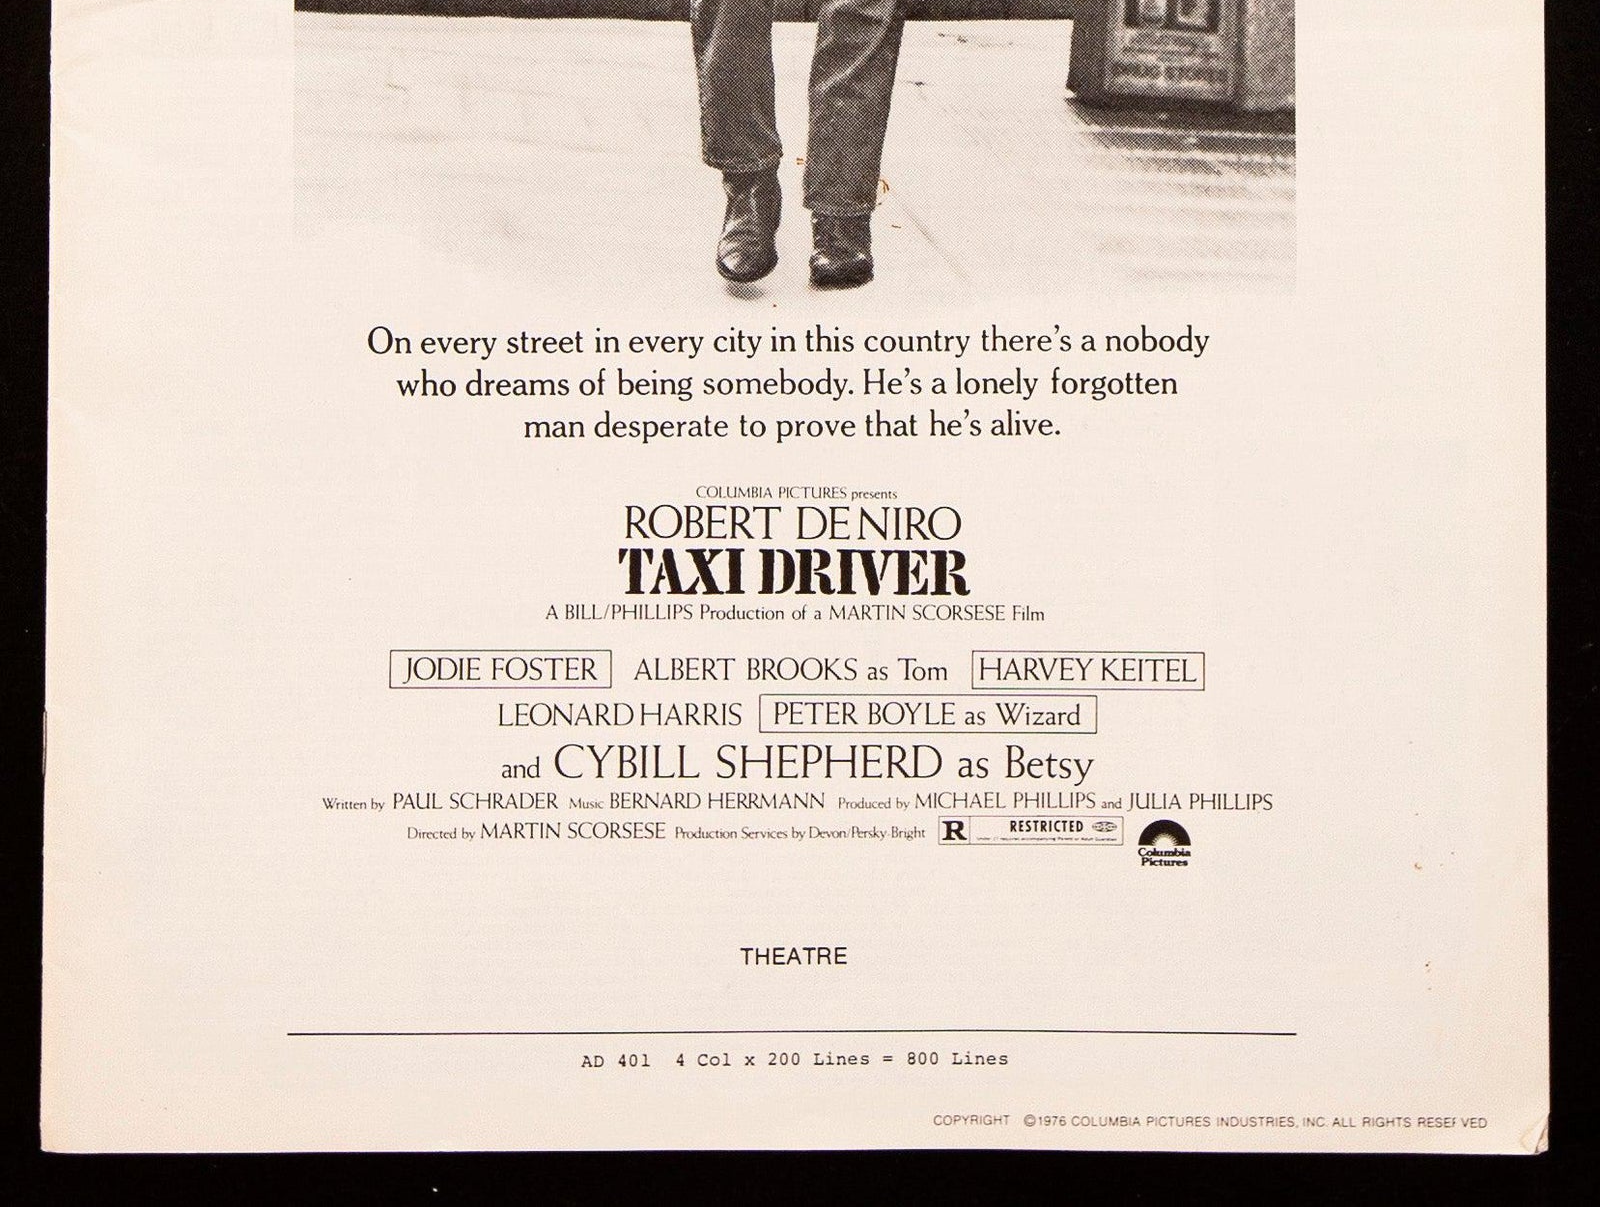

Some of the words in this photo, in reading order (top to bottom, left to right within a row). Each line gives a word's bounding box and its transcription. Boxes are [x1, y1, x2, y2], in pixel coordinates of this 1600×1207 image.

[367, 325, 412, 355] On
[420, 336, 498, 361] every
[506, 330, 584, 355] street
[594, 327, 621, 354] in
[628, 335, 705, 360] every
[713, 326, 763, 359] city
[770, 326, 797, 353] in
[805, 324, 855, 353] this
[863, 329, 971, 359] country
[981, 324, 1072, 353] there’s
[1080, 334, 1097, 352] a
[1105, 324, 1210, 359] nobody
[396, 368, 457, 397] who
[465, 368, 570, 397] dreams
[578, 367, 607, 397] of
[616, 367, 693, 402] being
[703, 367, 854, 402] somebody.
[863, 367, 923, 395] He’s
[931, 377, 948, 395] a
[955, 366, 1039, 401] lonely
[1051, 366, 1178, 402] forgotten
[524, 420, 585, 439] man
[593, 409, 729, 445] desperate
[739, 414, 767, 438] to
[776, 420, 856, 444] prove
[864, 409, 919, 437] that
[929, 409, 982, 437] he’s
[990, 409, 1061, 437] alive.
[695, 485, 773, 499] COLUMBIA
[778, 486, 848, 500] PICTURES
[850, 490, 898, 502] presents
[625, 504, 782, 540] ROBERT
[796, 506, 851, 541] DE
[857, 506, 962, 541] NIRO
[618, 547, 746, 596] TAXI
[757, 548, 971, 597] DRIVER
[545, 604, 559, 620] A
[565, 603, 693, 621] BILL/PHILLIPS
[700, 603, 785, 621] Production
[791, 604, 807, 621] of
[813, 609, 822, 621] a
[829, 604, 906, 621] MARTIN
[912, 604, 1006, 621] SCORSESE
[1012, 604, 1045, 622] Film
[402, 656, 481, 685] JODIE
[491, 656, 598, 681] FOSTER
[633, 657, 736, 681] ALBERT
[747, 656, 858, 681] BROOKS
[867, 666, 889, 681] as
[897, 657, 948, 682] Tom
[979, 657, 1094, 682] HARVEY
[1101, 657, 1198, 683] KEITEL
[498, 702, 635, 727] LEONARD
[640, 702, 742, 727] HARRIS
[774, 701, 859, 725] PETER
[868, 701, 956, 726] BOYLE
[964, 710, 986, 726] as
[995, 702, 1081, 726] Wizard
[501, 755, 541, 779] and
[554, 743, 700, 779] CYBILL
[716, 743, 943, 779] SHEPHERD
[957, 757, 989, 779] as
[1005, 744, 1095, 787] Betsy
[322, 797, 367, 810] Written
[370, 797, 386, 813] by
[393, 792, 443, 810] PAUL
[449, 792, 559, 810] SCHRADER
[568, 797, 604, 810] Music
[609, 791, 702, 810] BERNARD
[707, 791, 825, 810] HERRMANN
[838, 796, 892, 810] Produced
[895, 796, 911, 811] by
[914, 791, 1007, 809] MICHAEL
[1013, 791, 1096, 809] PHILLIPS
[1100, 797, 1123, 810] and
[1126, 792, 1182, 812] JULIA
[1189, 792, 1273, 811] PHILLIPS
[407, 826, 458, 840] Directed
[461, 826, 476, 842] by
[480, 821, 561, 840] MARTIN
[567, 821, 666, 840] SCORSESE
[674, 826, 738, 840] Production
[740, 826, 788, 840] Services
[791, 826, 807, 842] by
[942, 820, 968, 841] R
[1009, 819, 1084, 833] RESTRICTED
[1137, 847, 1192, 859] Columbia
[1140, 857, 1189, 867] Pictures
[739, 946, 848, 966] THEATRE
[580, 1054, 605, 1069] AD
[675, 1053, 685, 1067] 4
[697, 1052, 732, 1067] Col
[744, 1055, 756, 1067] x
[767, 1051, 801, 1066] 200
[813, 1051, 870, 1066] Lines
[907, 1051, 939, 1066] 800
[951, 1050, 1009, 1066] Lines
[932, 1114, 1011, 1127] COPYRIGHT
[1070, 1115, 1141, 1128] COLUMBIA
[1146, 1115, 1211, 1128] PICTURES
[1216, 1115, 1299, 1128] INDUSTRIES,
[1331, 1116, 1357, 1128] ALL
[1361, 1116, 1412, 1129] RIGHTS
